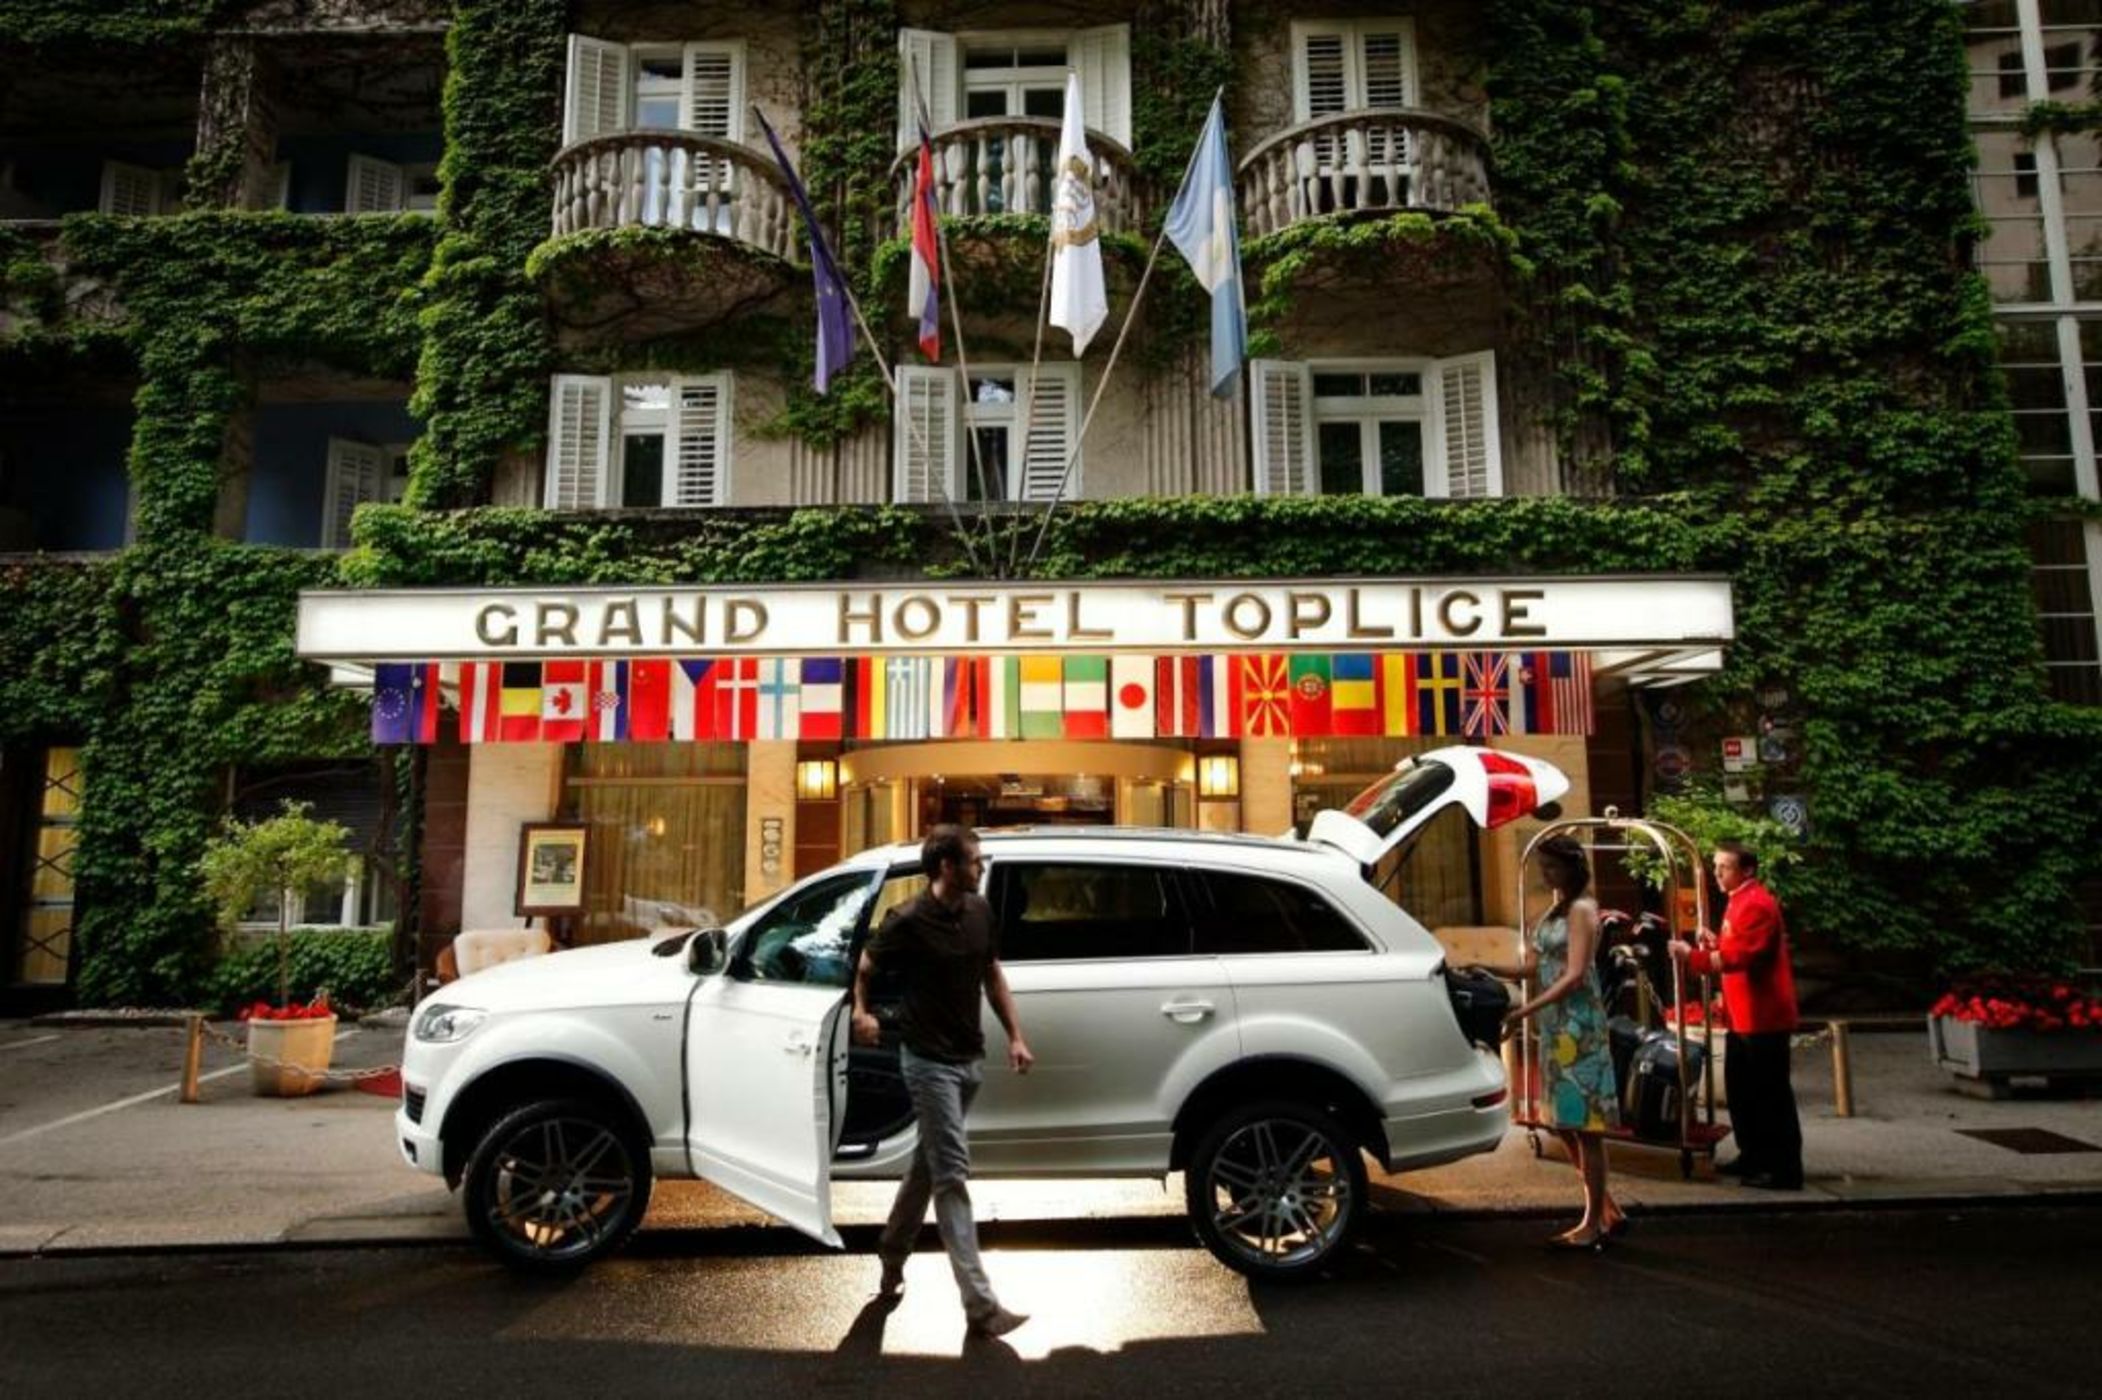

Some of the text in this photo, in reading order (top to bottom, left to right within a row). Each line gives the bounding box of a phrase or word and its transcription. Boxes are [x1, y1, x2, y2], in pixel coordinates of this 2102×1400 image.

[476, 586, 1547, 646] GRAND HOTEL TOPLICE
